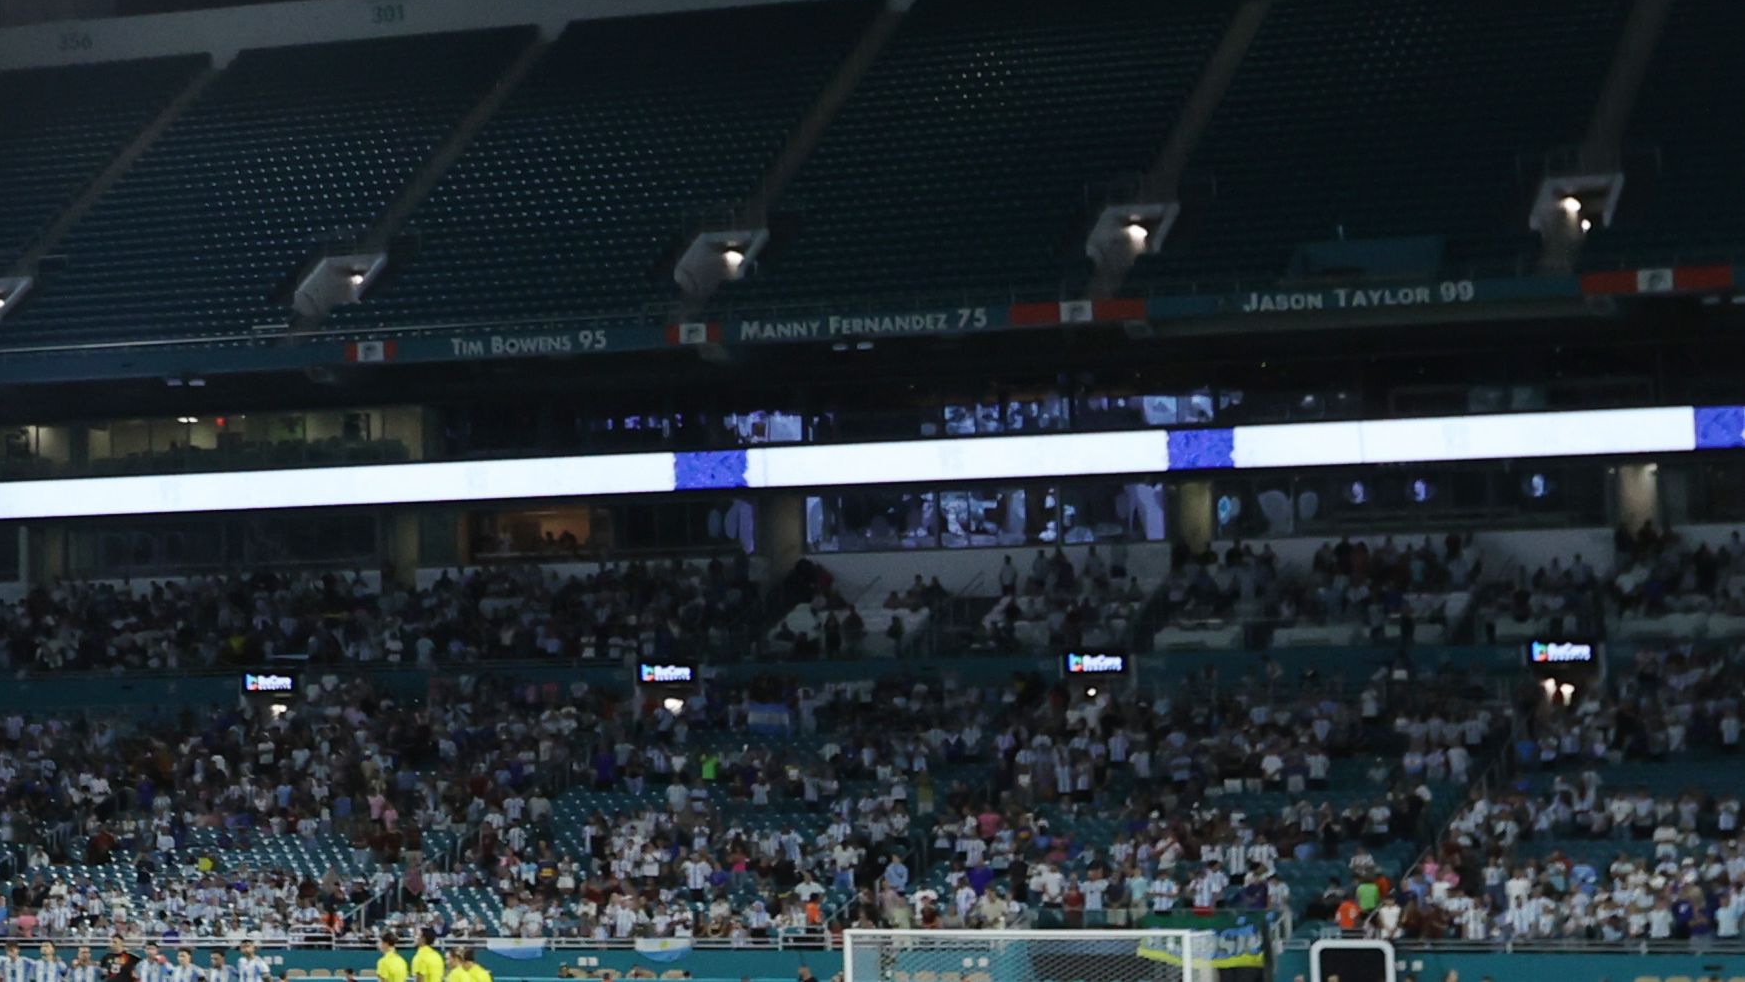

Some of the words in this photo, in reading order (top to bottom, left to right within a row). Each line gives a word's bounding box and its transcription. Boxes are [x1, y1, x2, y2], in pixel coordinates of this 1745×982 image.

[372, 4, 405, 25] 301
[1439, 279, 1475, 302] 99
[956, 307, 988, 328] 75
[577, 329, 607, 350] 95
